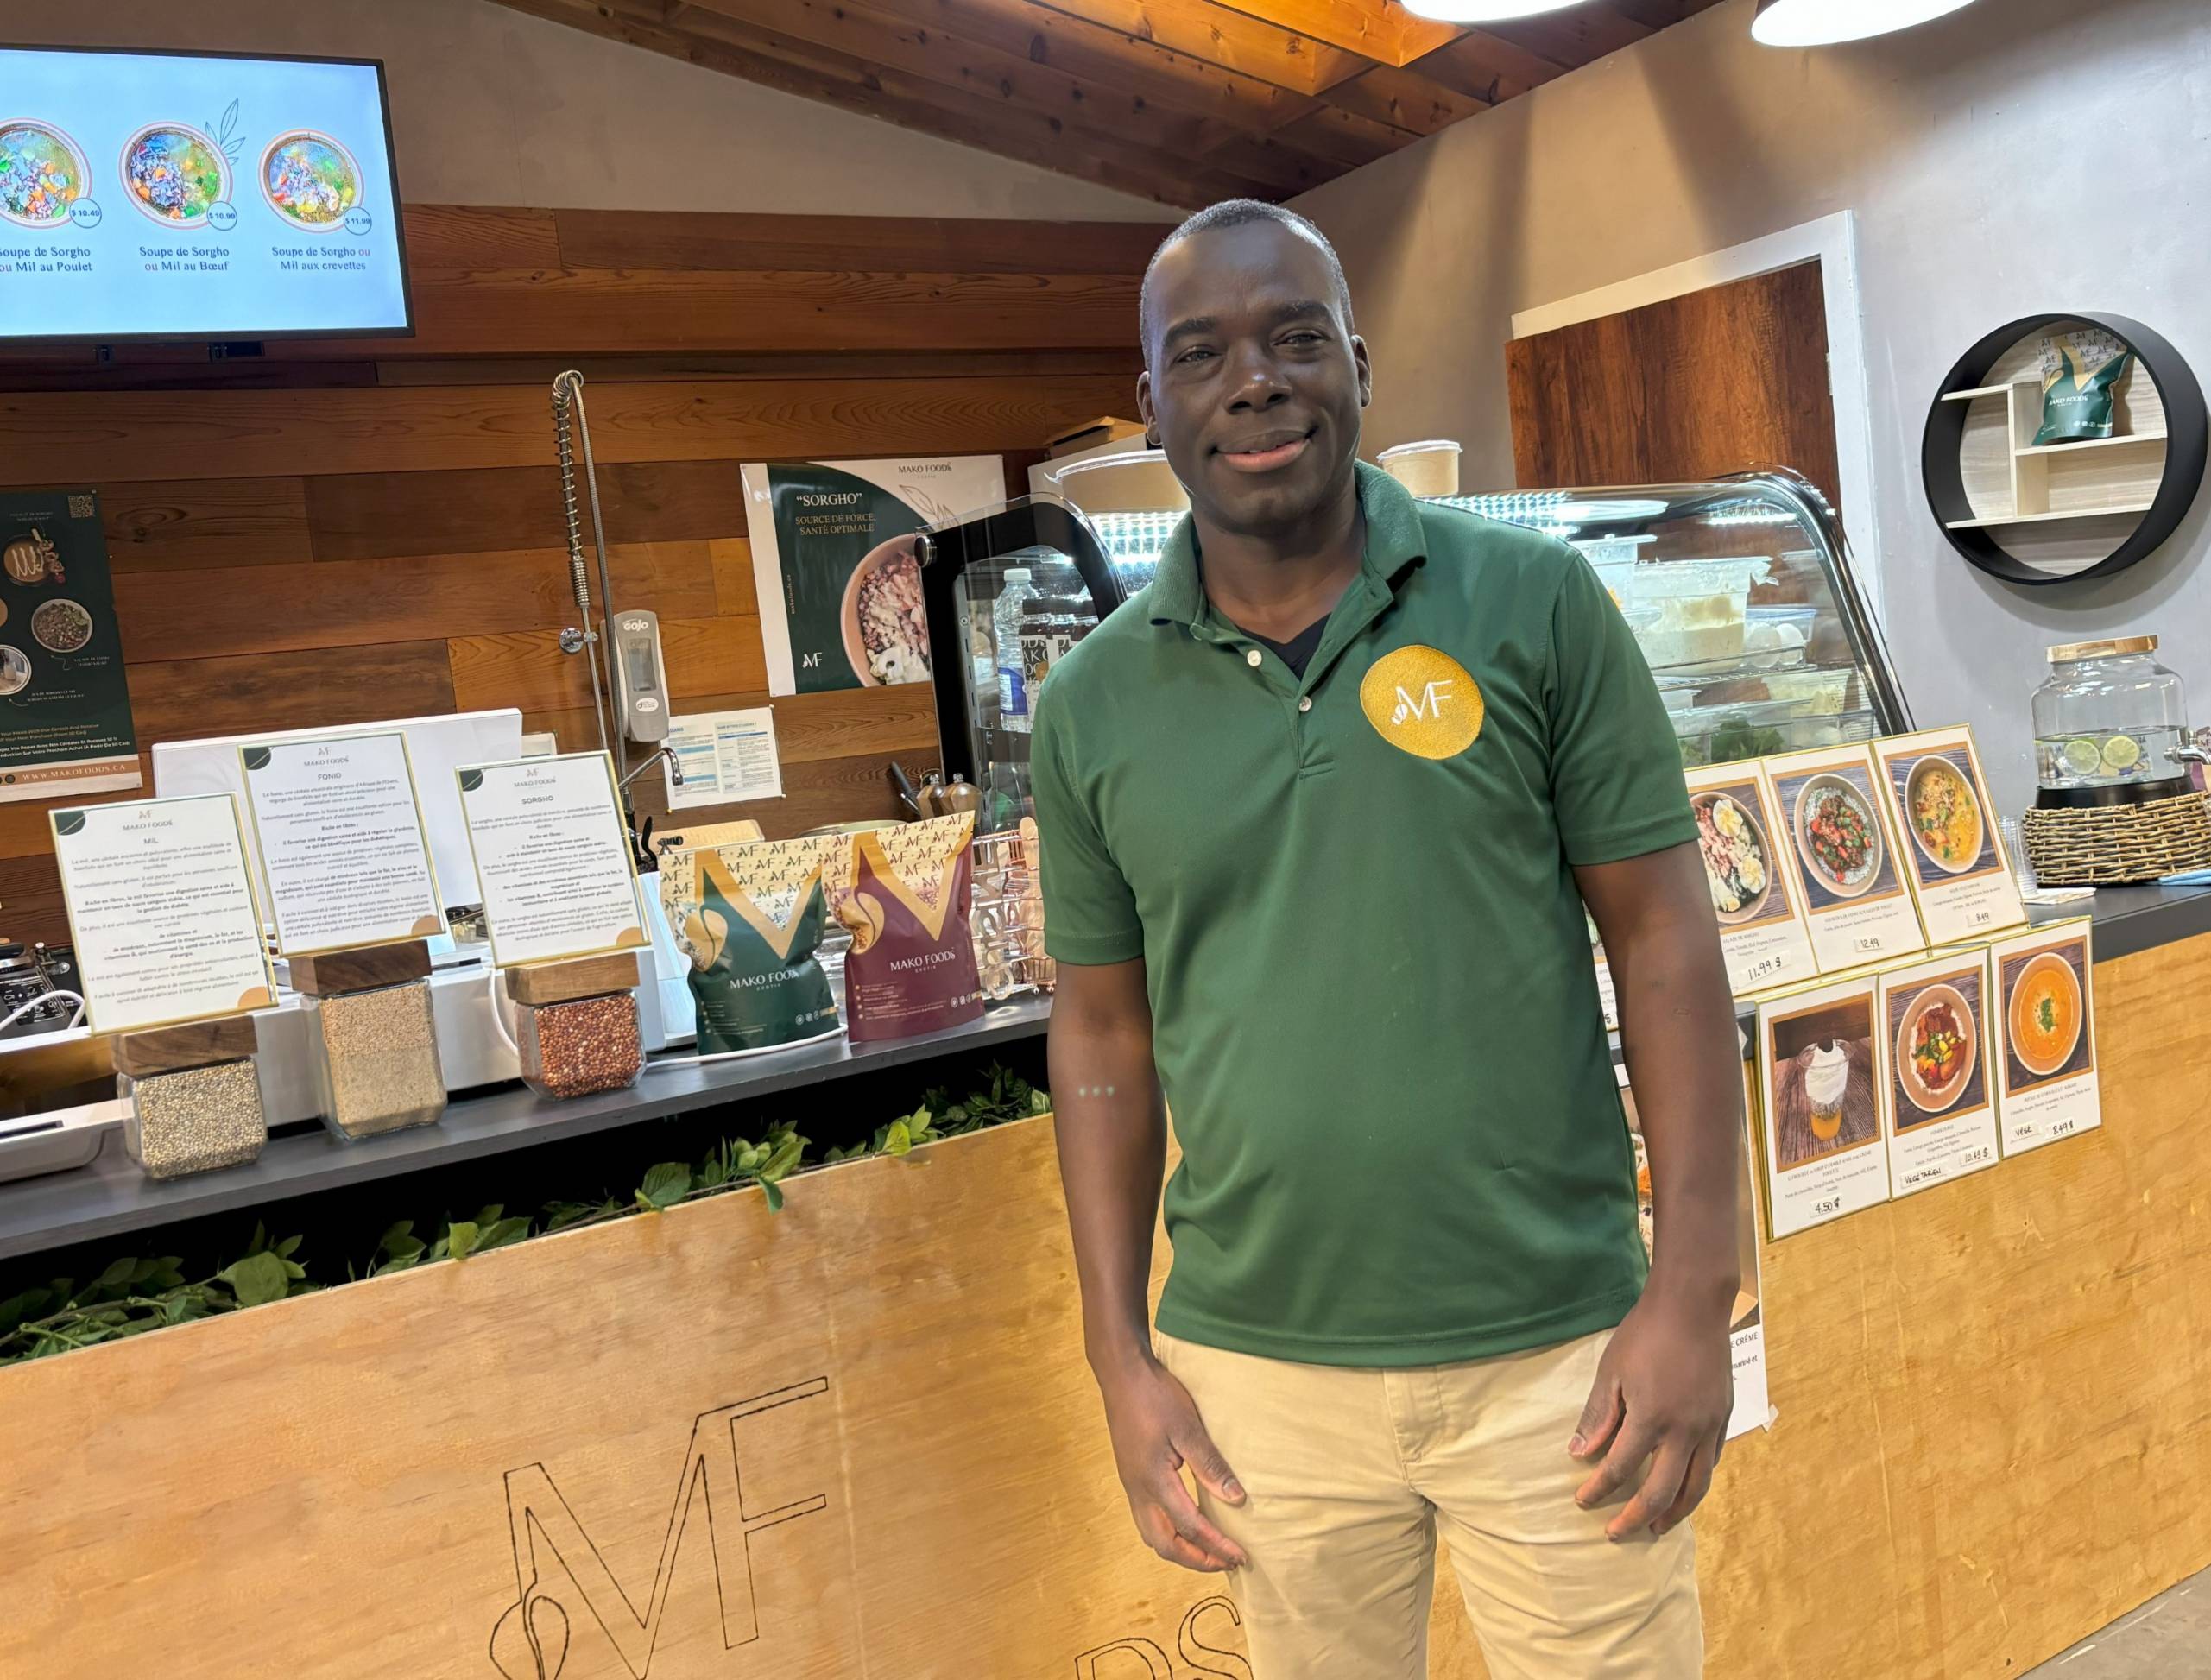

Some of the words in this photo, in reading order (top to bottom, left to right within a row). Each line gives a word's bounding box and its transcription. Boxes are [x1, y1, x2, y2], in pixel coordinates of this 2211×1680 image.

[35, 246, 47, 256] de
[50, 246, 91, 259] Sorgho
[139, 246, 173, 257] Soupe
[176, 246, 189, 256] de
[191, 246, 230, 258] Sorgho
[272, 246, 303, 258] Soupe
[306, 246, 318, 256] de
[320, 246, 356, 258] Sorgho
[358, 248, 370, 256] ou
[16, 262, 36, 272] Mil
[40, 263, 53, 272] au
[57, 262, 93, 272] Poulet
[145, 262, 158, 271] ou
[161, 261, 180, 271] Mil
[184, 262, 196, 271] au
[281, 261, 298, 270] Mil
[322, 261, 366, 270] crevettes
[899, 465, 924, 474] MAKO
[925, 464, 952, 473] FOODS
[795, 515, 831, 525] SOURCE
[831, 515, 844, 524] DE
[799, 524, 830, 535] SANTÉ
[831, 523, 875, 534] OPTIMALE
[527, 679, 590, 725] MF
[22, 764, 125, 780] WWW.MAKOFOODS.CA
[318, 772, 341, 781] FONIO
[521, 795, 554, 805] SORGHO
[890, 957, 923, 971] MAKO
[925, 950, 956, 964] FOODS
[1748, 960, 1772, 981] 11.99
[730, 975, 765, 989] MAKO
